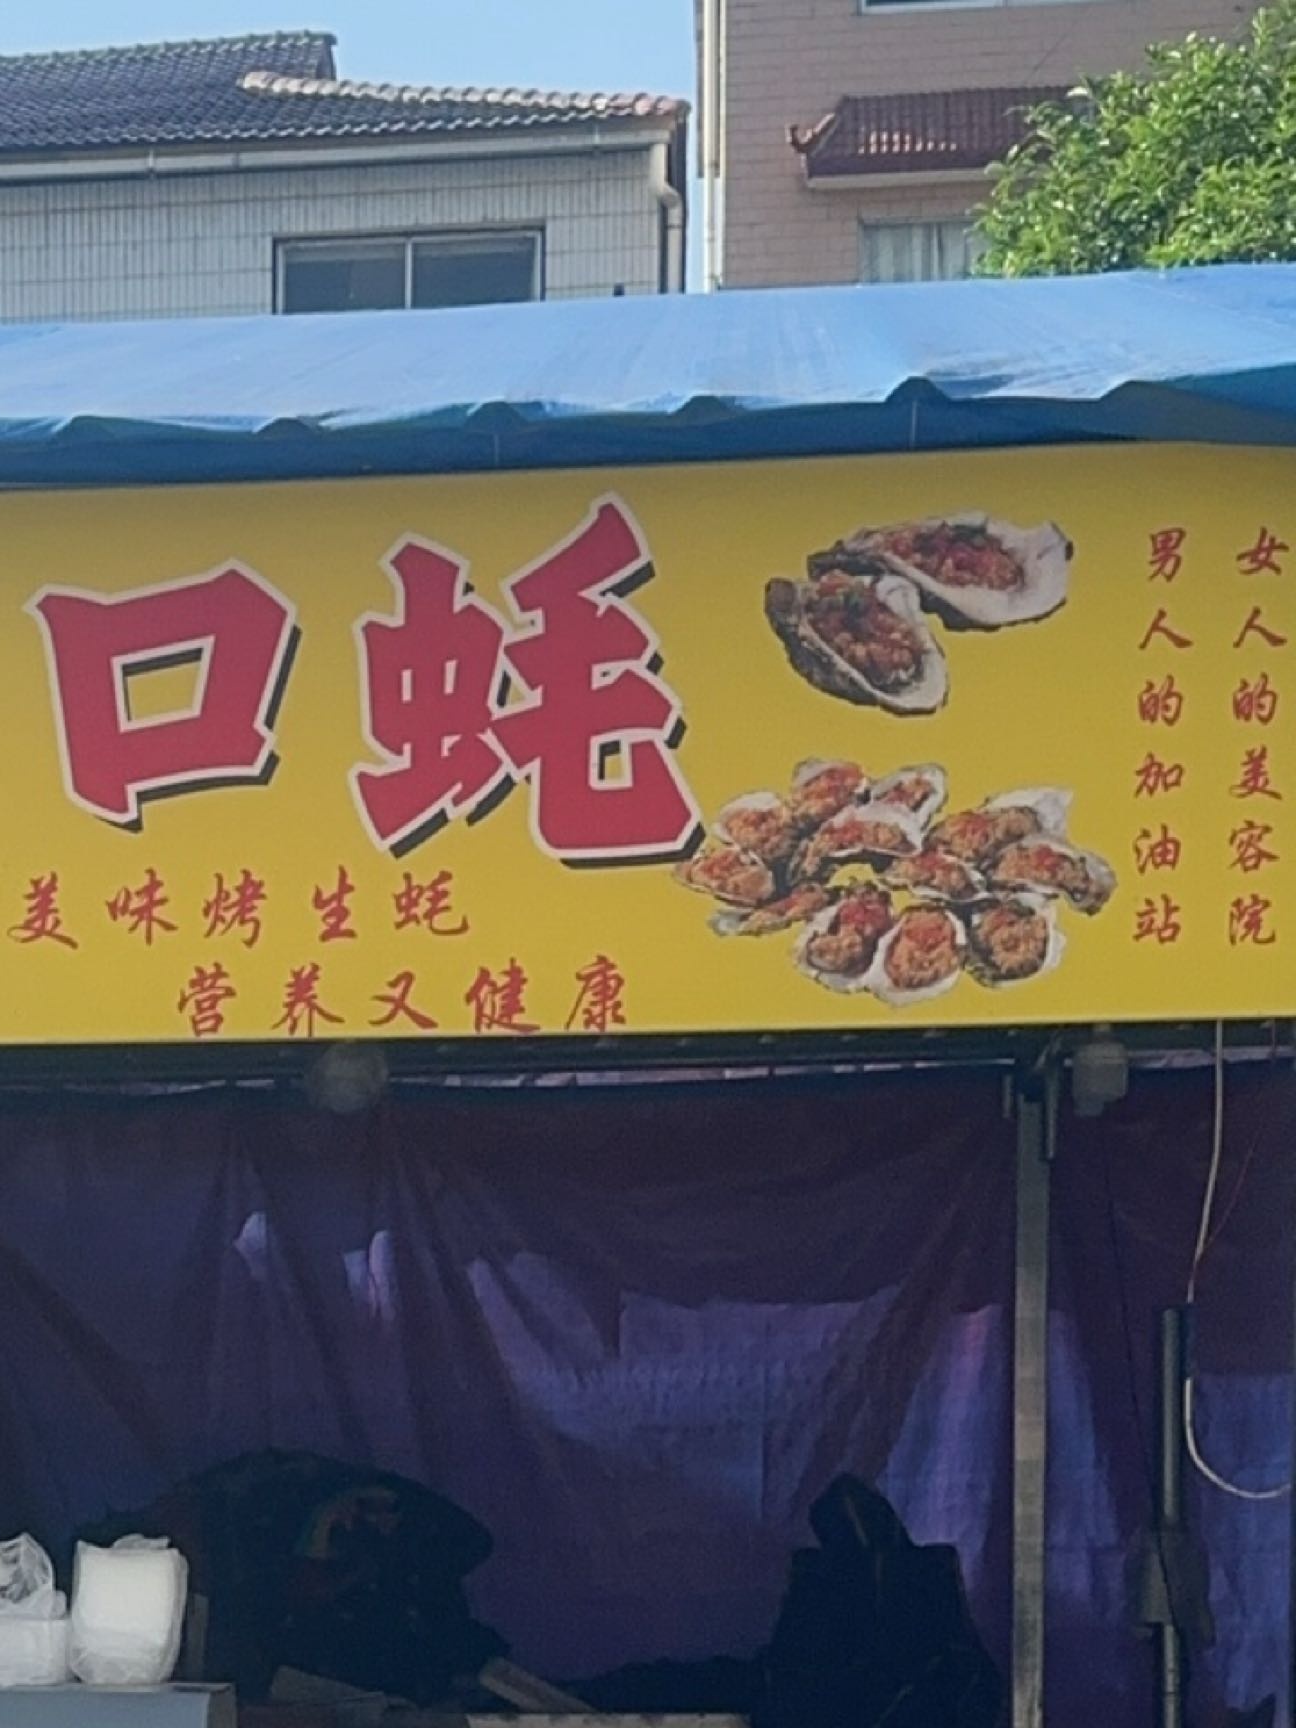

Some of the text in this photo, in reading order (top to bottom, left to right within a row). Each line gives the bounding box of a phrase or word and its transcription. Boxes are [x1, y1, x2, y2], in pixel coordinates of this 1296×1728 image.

[1133, 527, 1194, 946] 男人的加油站
[1228, 527, 1290, 946] 女人的美容院
[6, 870, 471, 950] 美味烤生蚝
[176, 959, 629, 1036] 营养又健康
